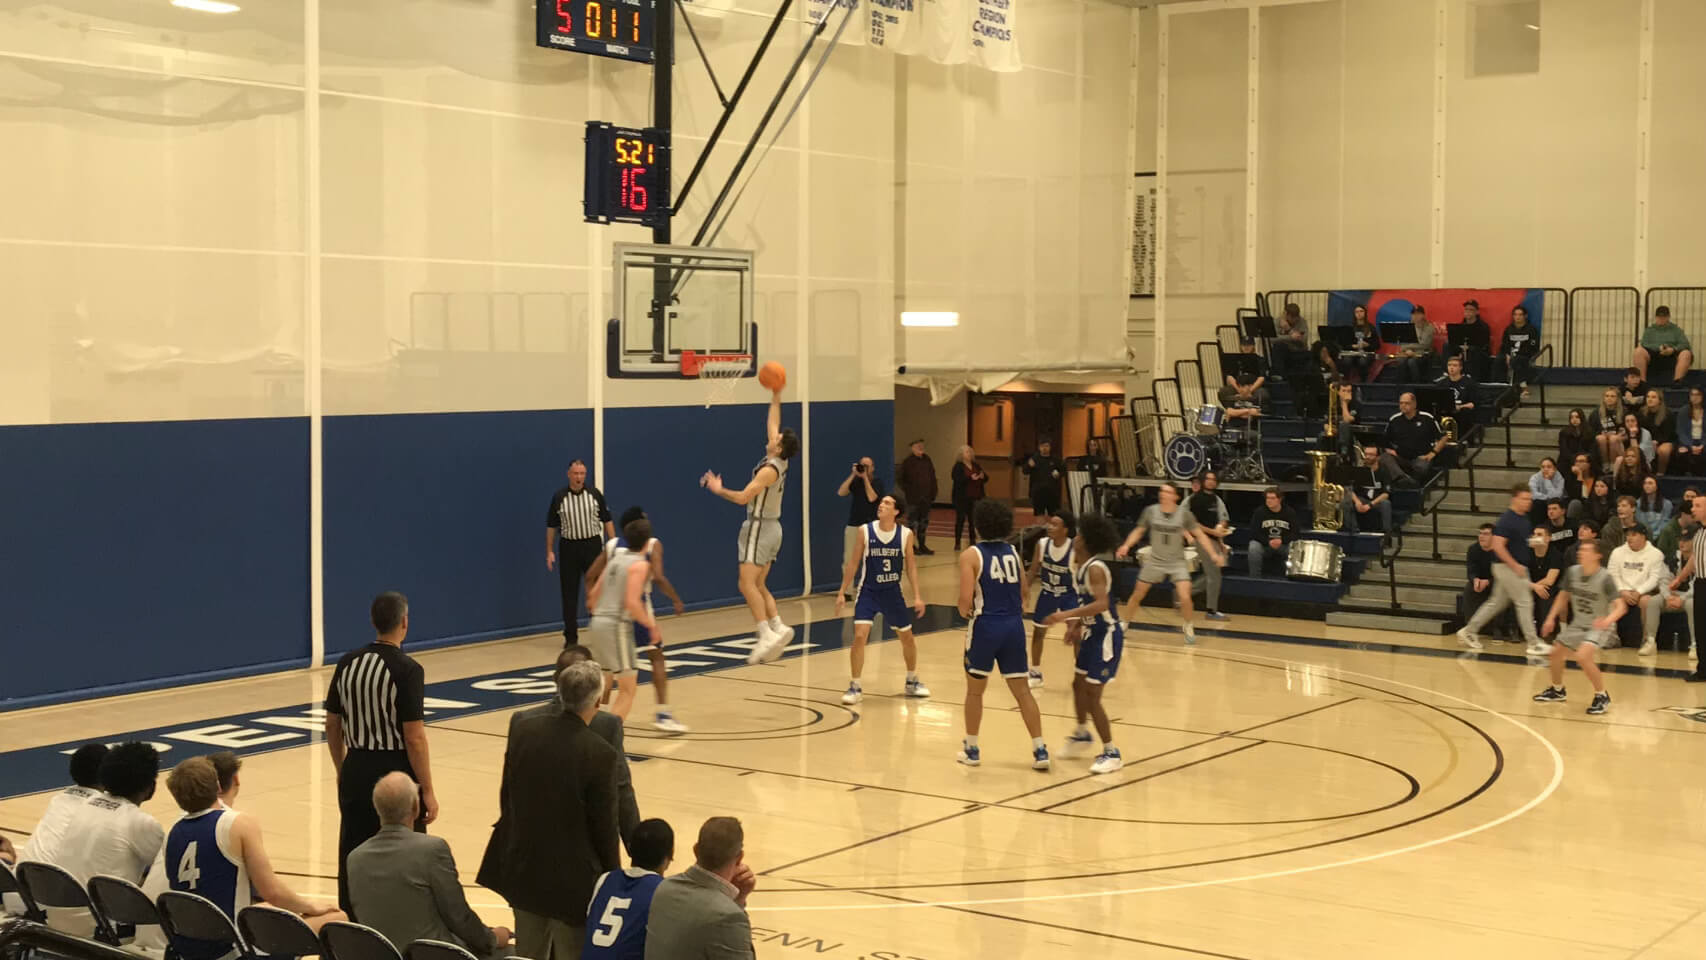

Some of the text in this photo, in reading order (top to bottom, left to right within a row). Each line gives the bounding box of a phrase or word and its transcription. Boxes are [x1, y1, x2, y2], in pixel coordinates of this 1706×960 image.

[621, 167, 648, 210] 16
[871, 548, 900, 557] HILBERT
[882, 559, 892, 572] 3
[989, 554, 1019, 584] 40
[178, 840, 201, 889] 4
[592, 895, 633, 947] 5
[751, 927, 844, 953] ENN
